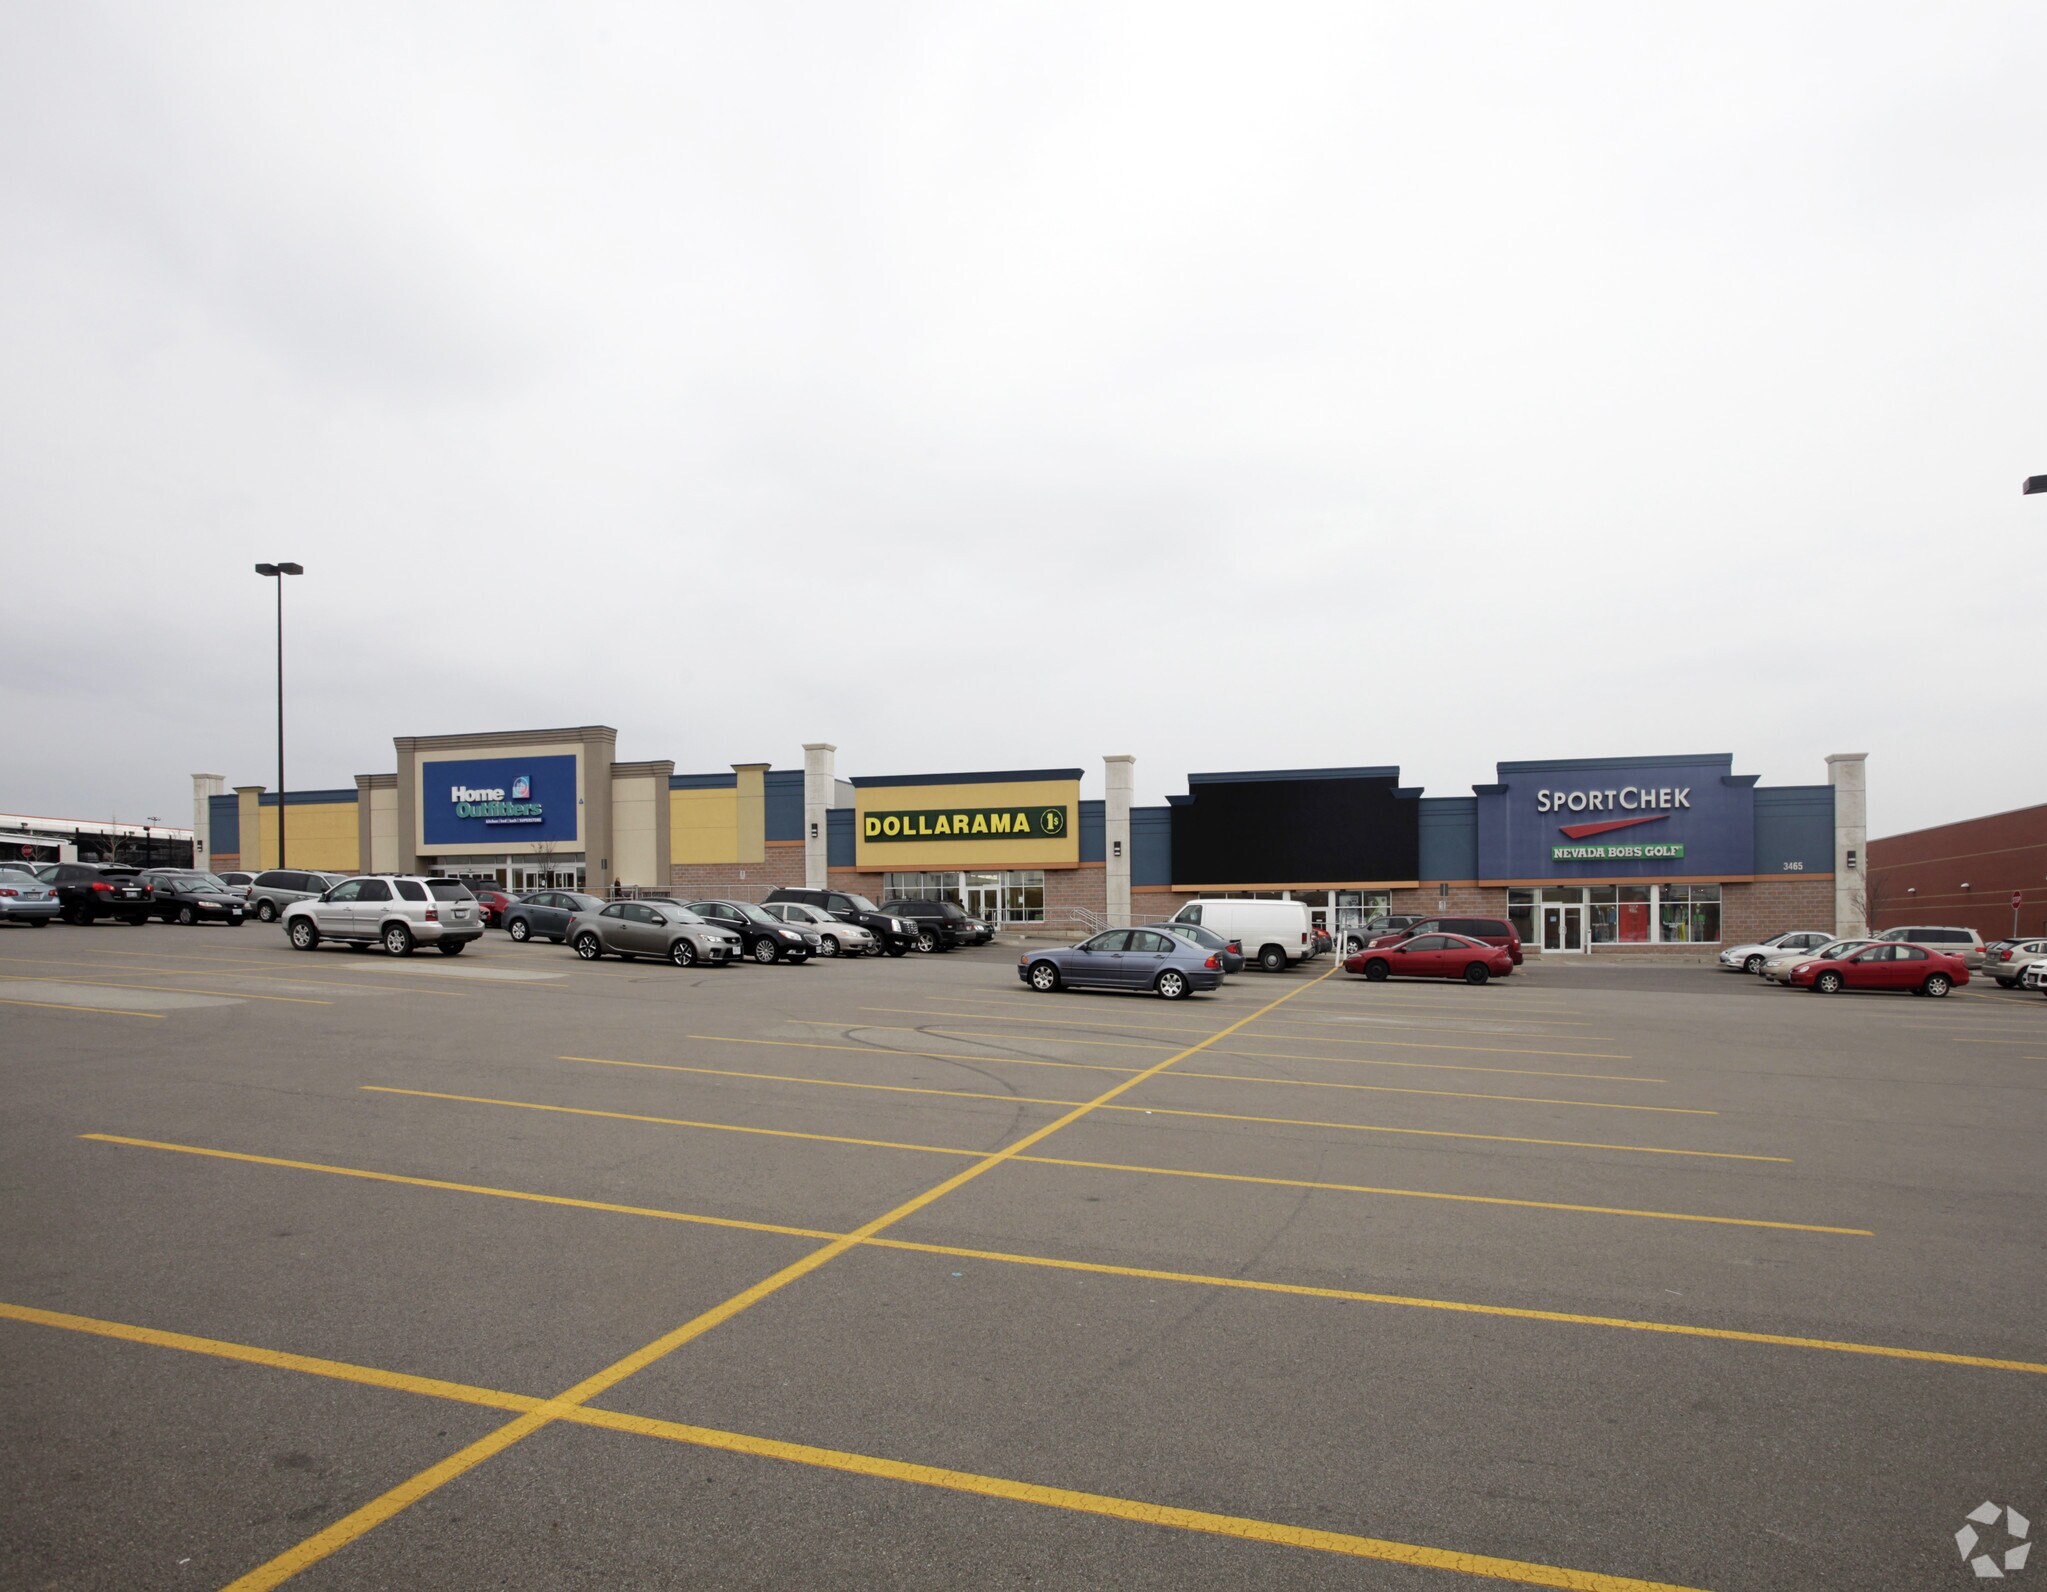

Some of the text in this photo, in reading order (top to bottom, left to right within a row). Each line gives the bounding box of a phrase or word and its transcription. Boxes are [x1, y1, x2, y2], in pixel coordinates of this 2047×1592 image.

[451, 786, 505, 803] Home
[1537, 787, 1691, 812] SPORTCHEK
[456, 801, 543, 818] Outfitters
[865, 813, 1031, 837] DOLLARAMA
[1553, 848, 1606, 859] NEVADA
[1644, 846, 1679, 857] GOLF
[1783, 861, 1804, 871] 3465
